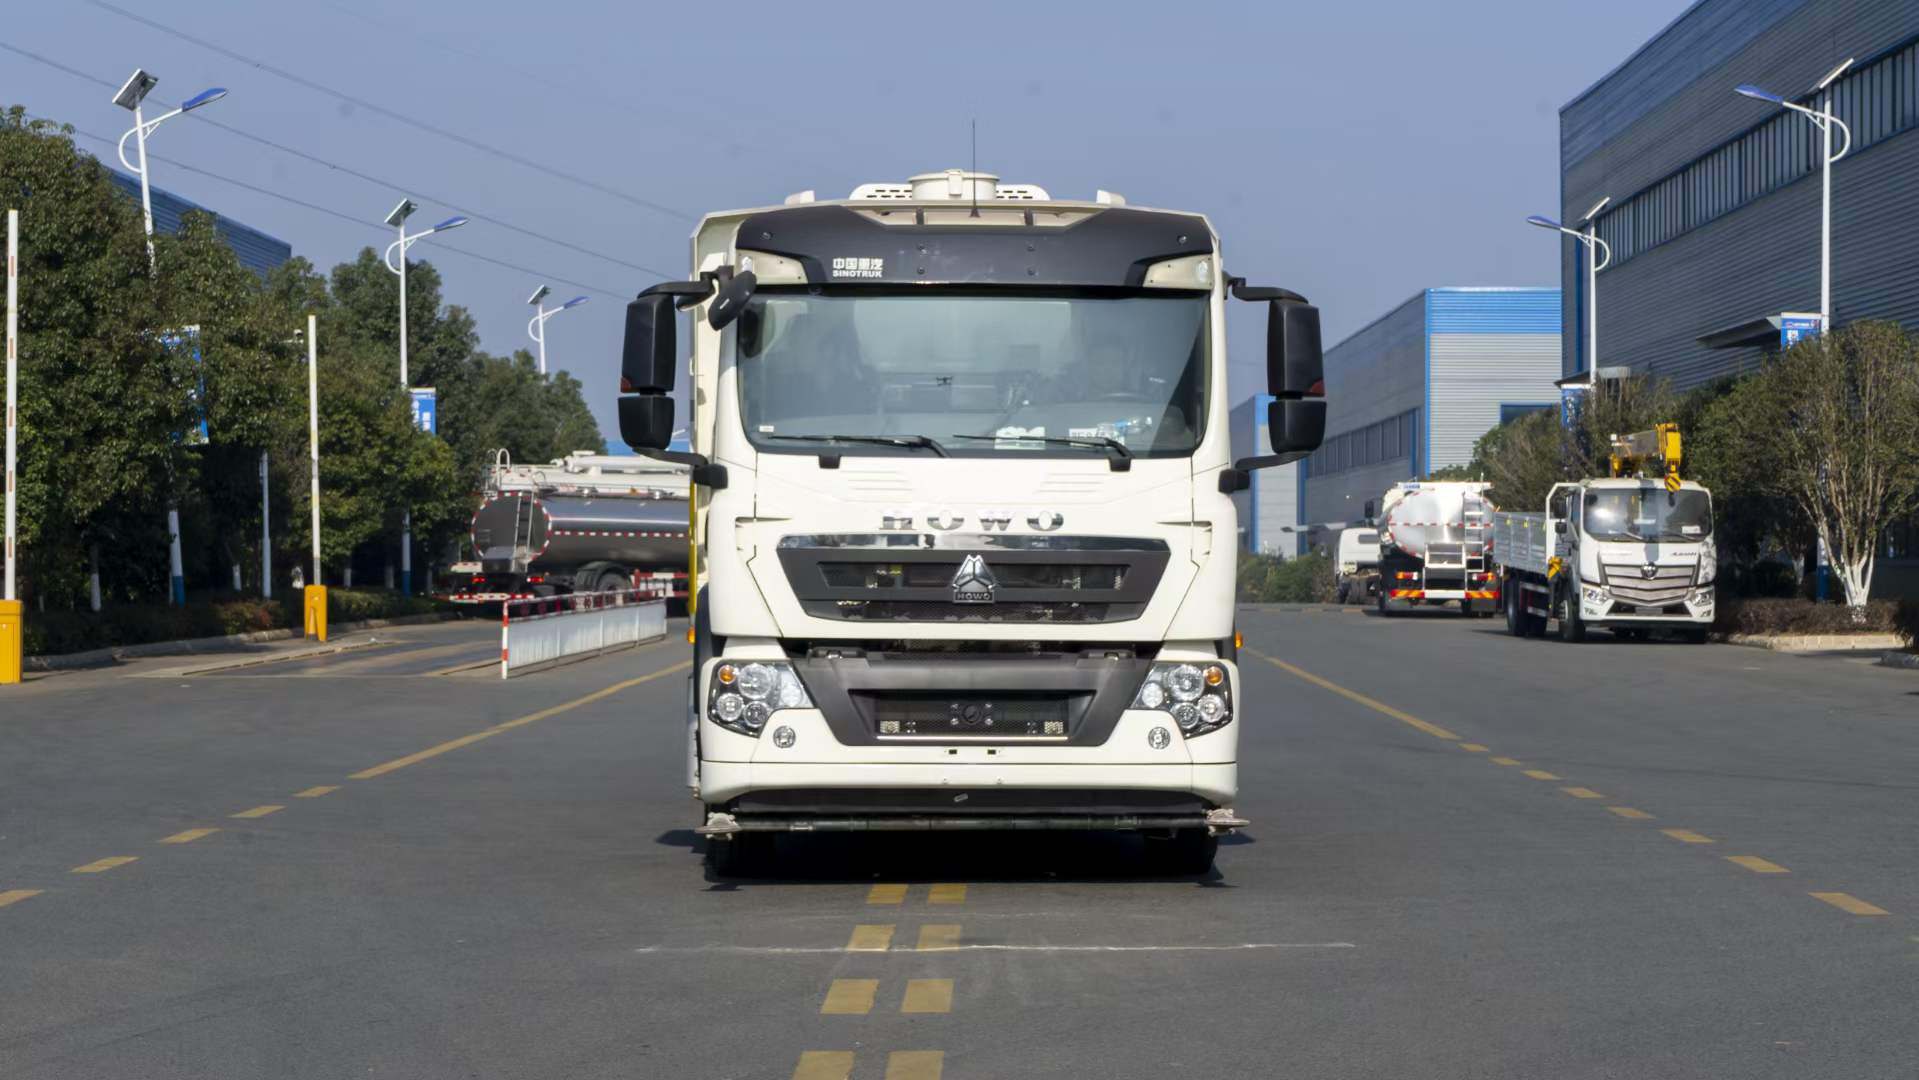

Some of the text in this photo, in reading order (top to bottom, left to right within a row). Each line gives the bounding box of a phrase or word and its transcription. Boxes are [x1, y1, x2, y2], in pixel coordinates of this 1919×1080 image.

[832, 269, 882, 278] SINOTRUK
[881, 510, 1065, 532] HOWO
[957, 592, 991, 600] HOWO
